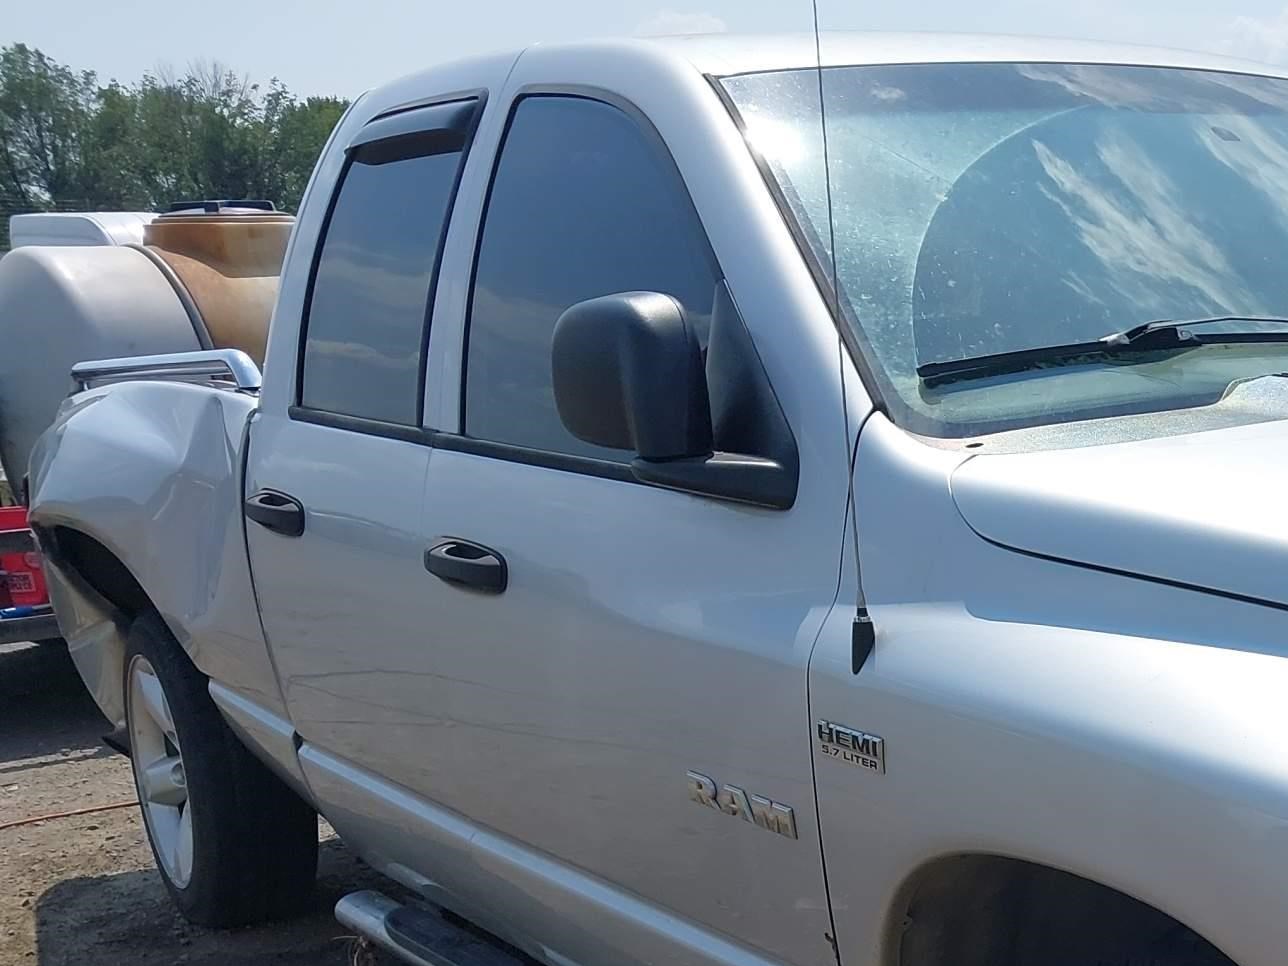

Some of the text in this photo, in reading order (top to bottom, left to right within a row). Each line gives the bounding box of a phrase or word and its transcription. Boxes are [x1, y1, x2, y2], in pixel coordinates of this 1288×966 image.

[817, 719, 880, 757] HEMI
[821, 744, 878, 771] 5.7 LITER
[686, 769, 799, 840] RAM
